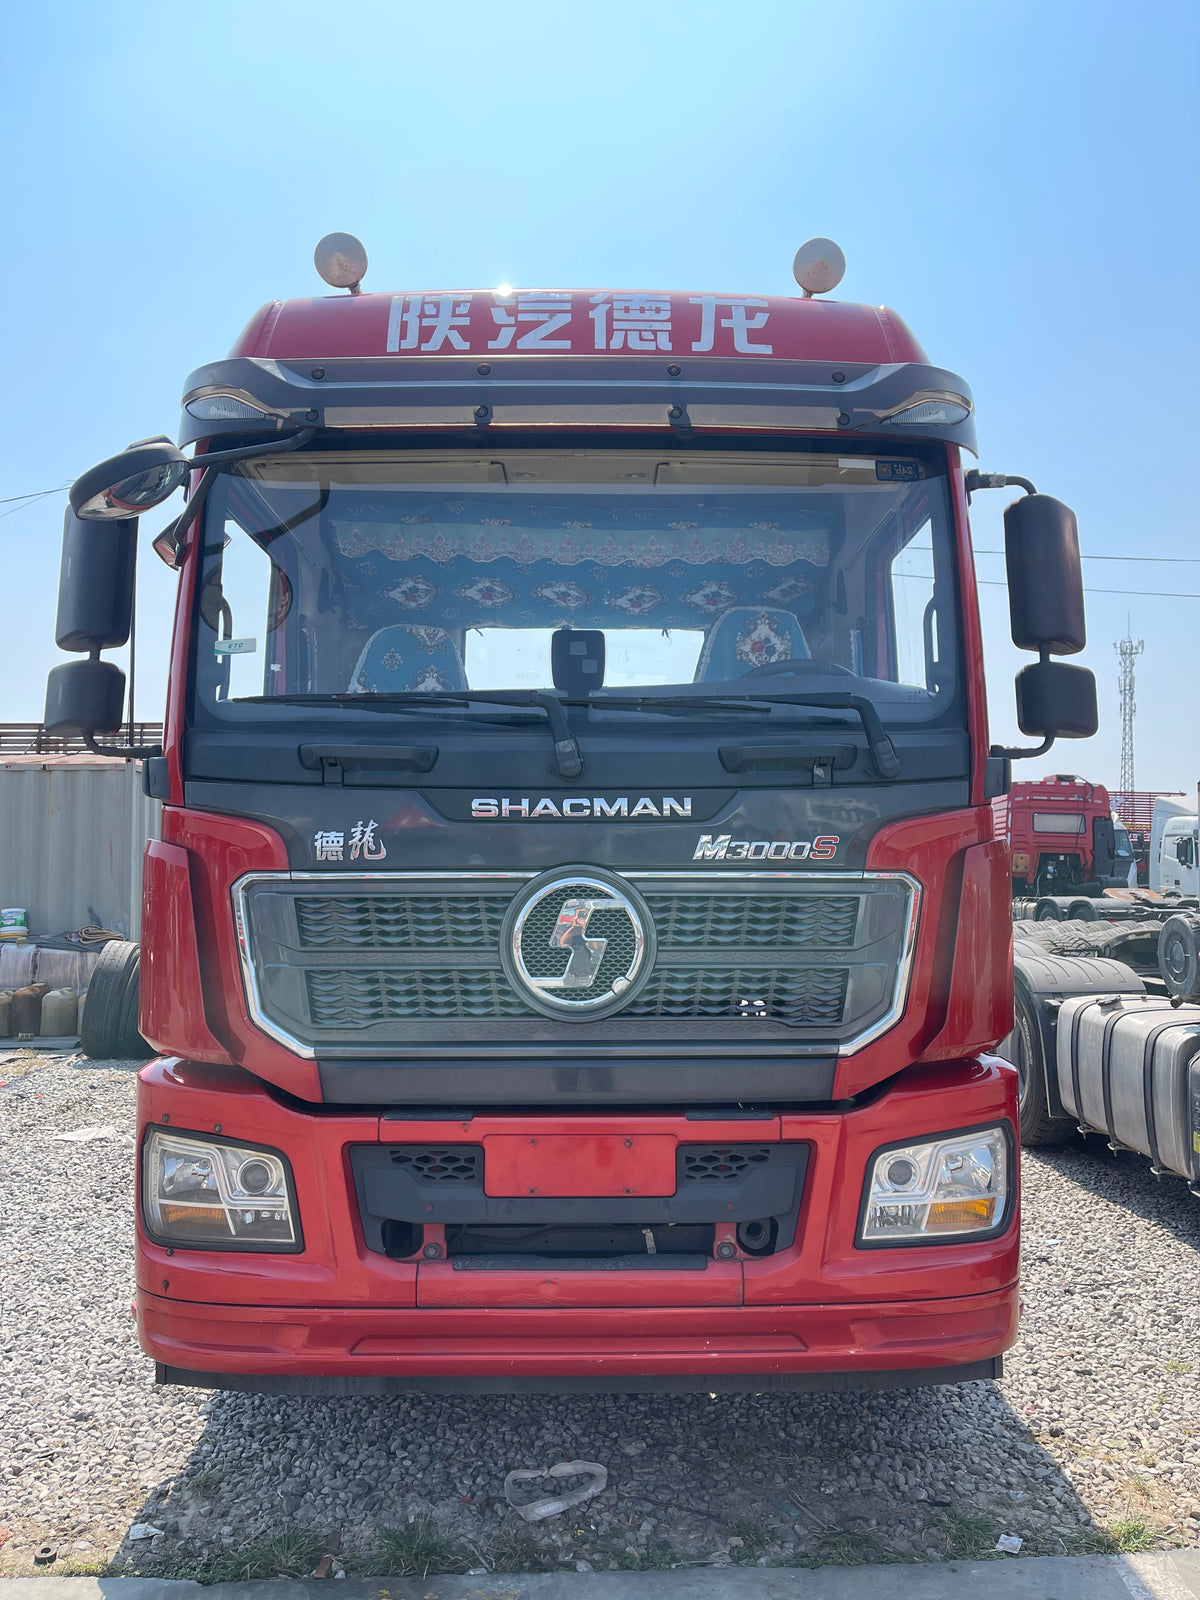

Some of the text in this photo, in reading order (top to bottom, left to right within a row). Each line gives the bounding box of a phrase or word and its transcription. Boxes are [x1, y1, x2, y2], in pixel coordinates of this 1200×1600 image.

[386, 292, 773, 355] 陕汽德龙
[471, 797, 692, 818] SHACMAN
[692, 834, 840, 860] M3000S
